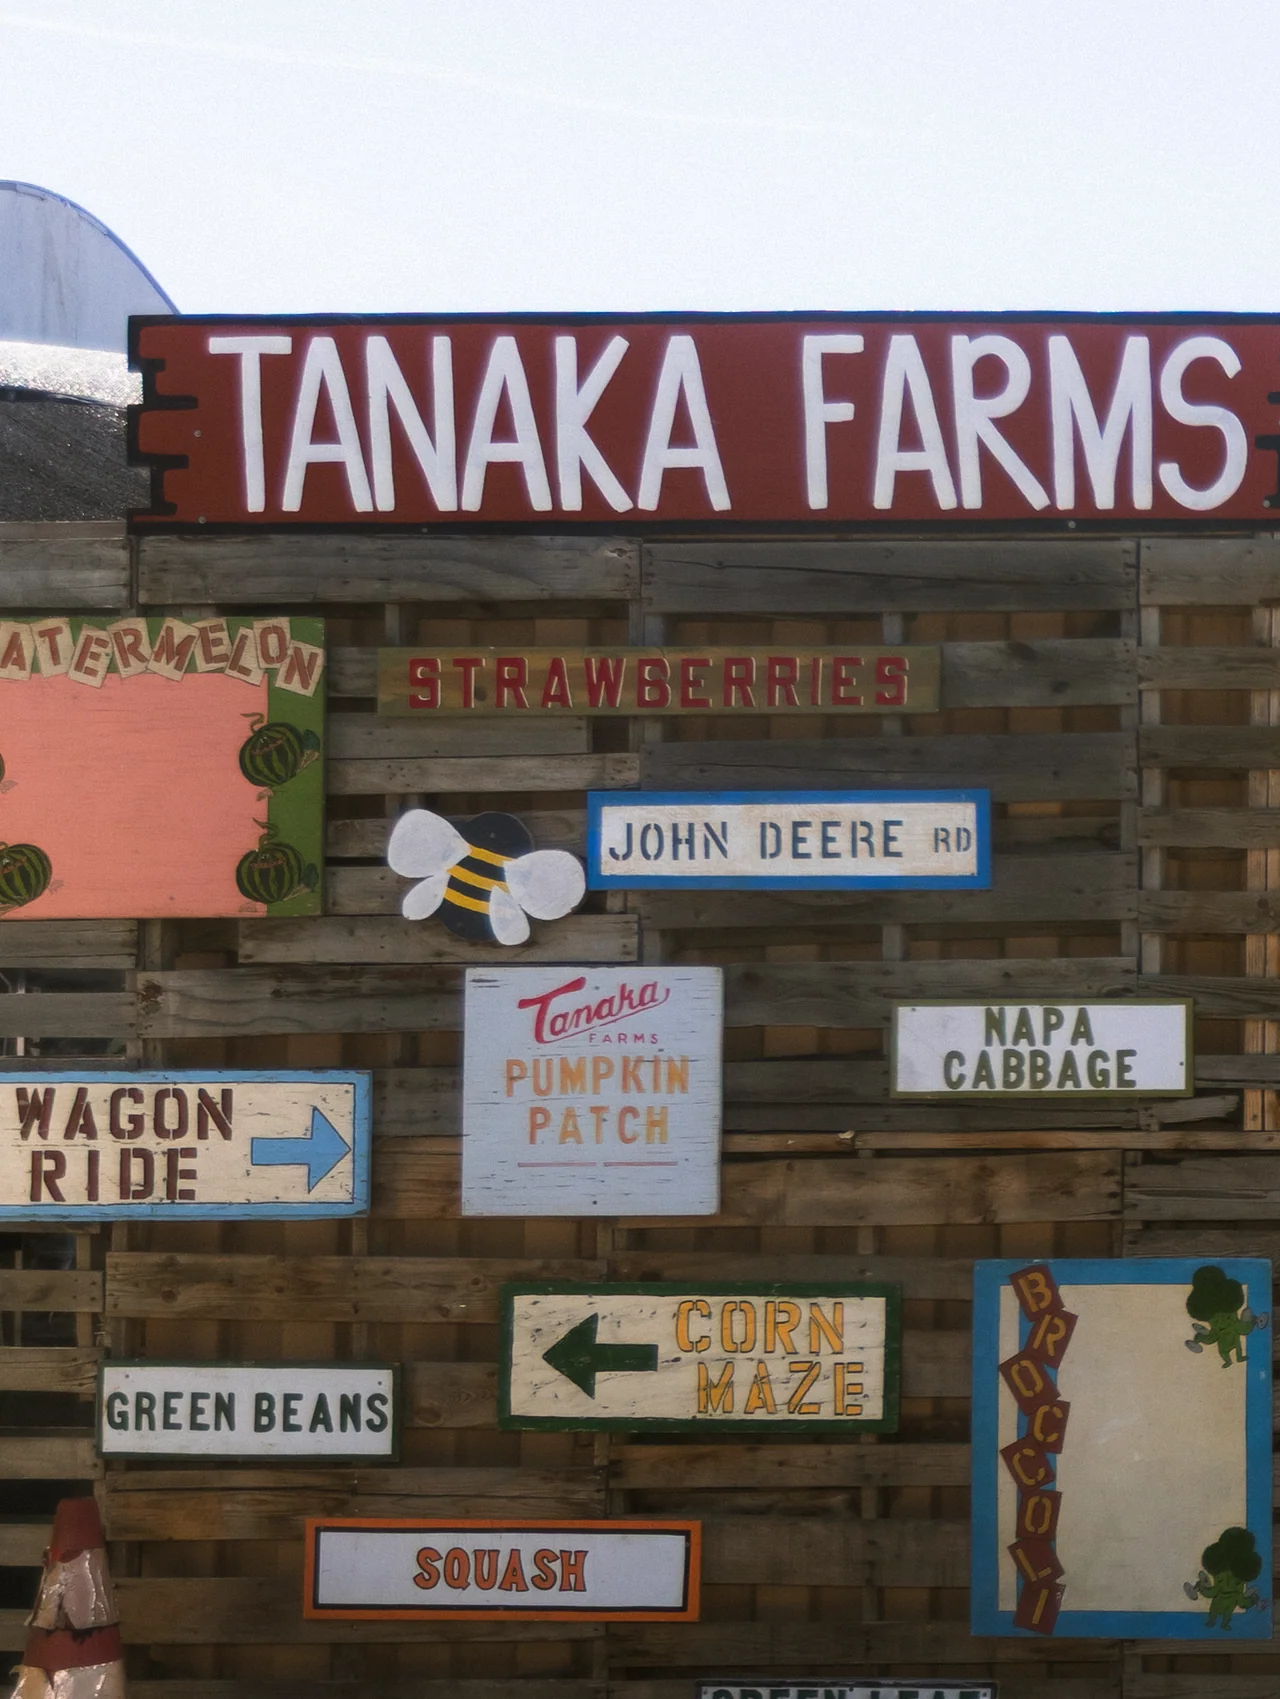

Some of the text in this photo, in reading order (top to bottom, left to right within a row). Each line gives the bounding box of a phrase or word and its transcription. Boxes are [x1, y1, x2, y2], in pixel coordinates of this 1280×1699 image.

[209, 334, 1247, 513] TANAKA FARMS
[0, 622, 319, 690] ATERMELON
[408, 656, 910, 709] STRAWBERRIES
[608, 820, 972, 861] JOHN DEERE RD
[518, 976, 670, 1044] Tanaka
[985, 1007, 1094, 1047] NAPA
[589, 1033, 658, 1044] FARMS
[504, 1056, 689, 1097] PUMPKIN
[943, 1048, 1137, 1091] CABBAGE
[16, 1087, 233, 1141] WAGON
[529, 1105, 668, 1145] PATCH
[30, 1147, 197, 1202] RIDE
[676, 1300, 843, 1354] CORN
[106, 1392, 388, 1433] GREEN BEANS
[698, 1361, 863, 1416] MAZE
[1012, 1271, 1067, 1624] BROCCOLI
[413, 1546, 588, 1593] SQUASH
